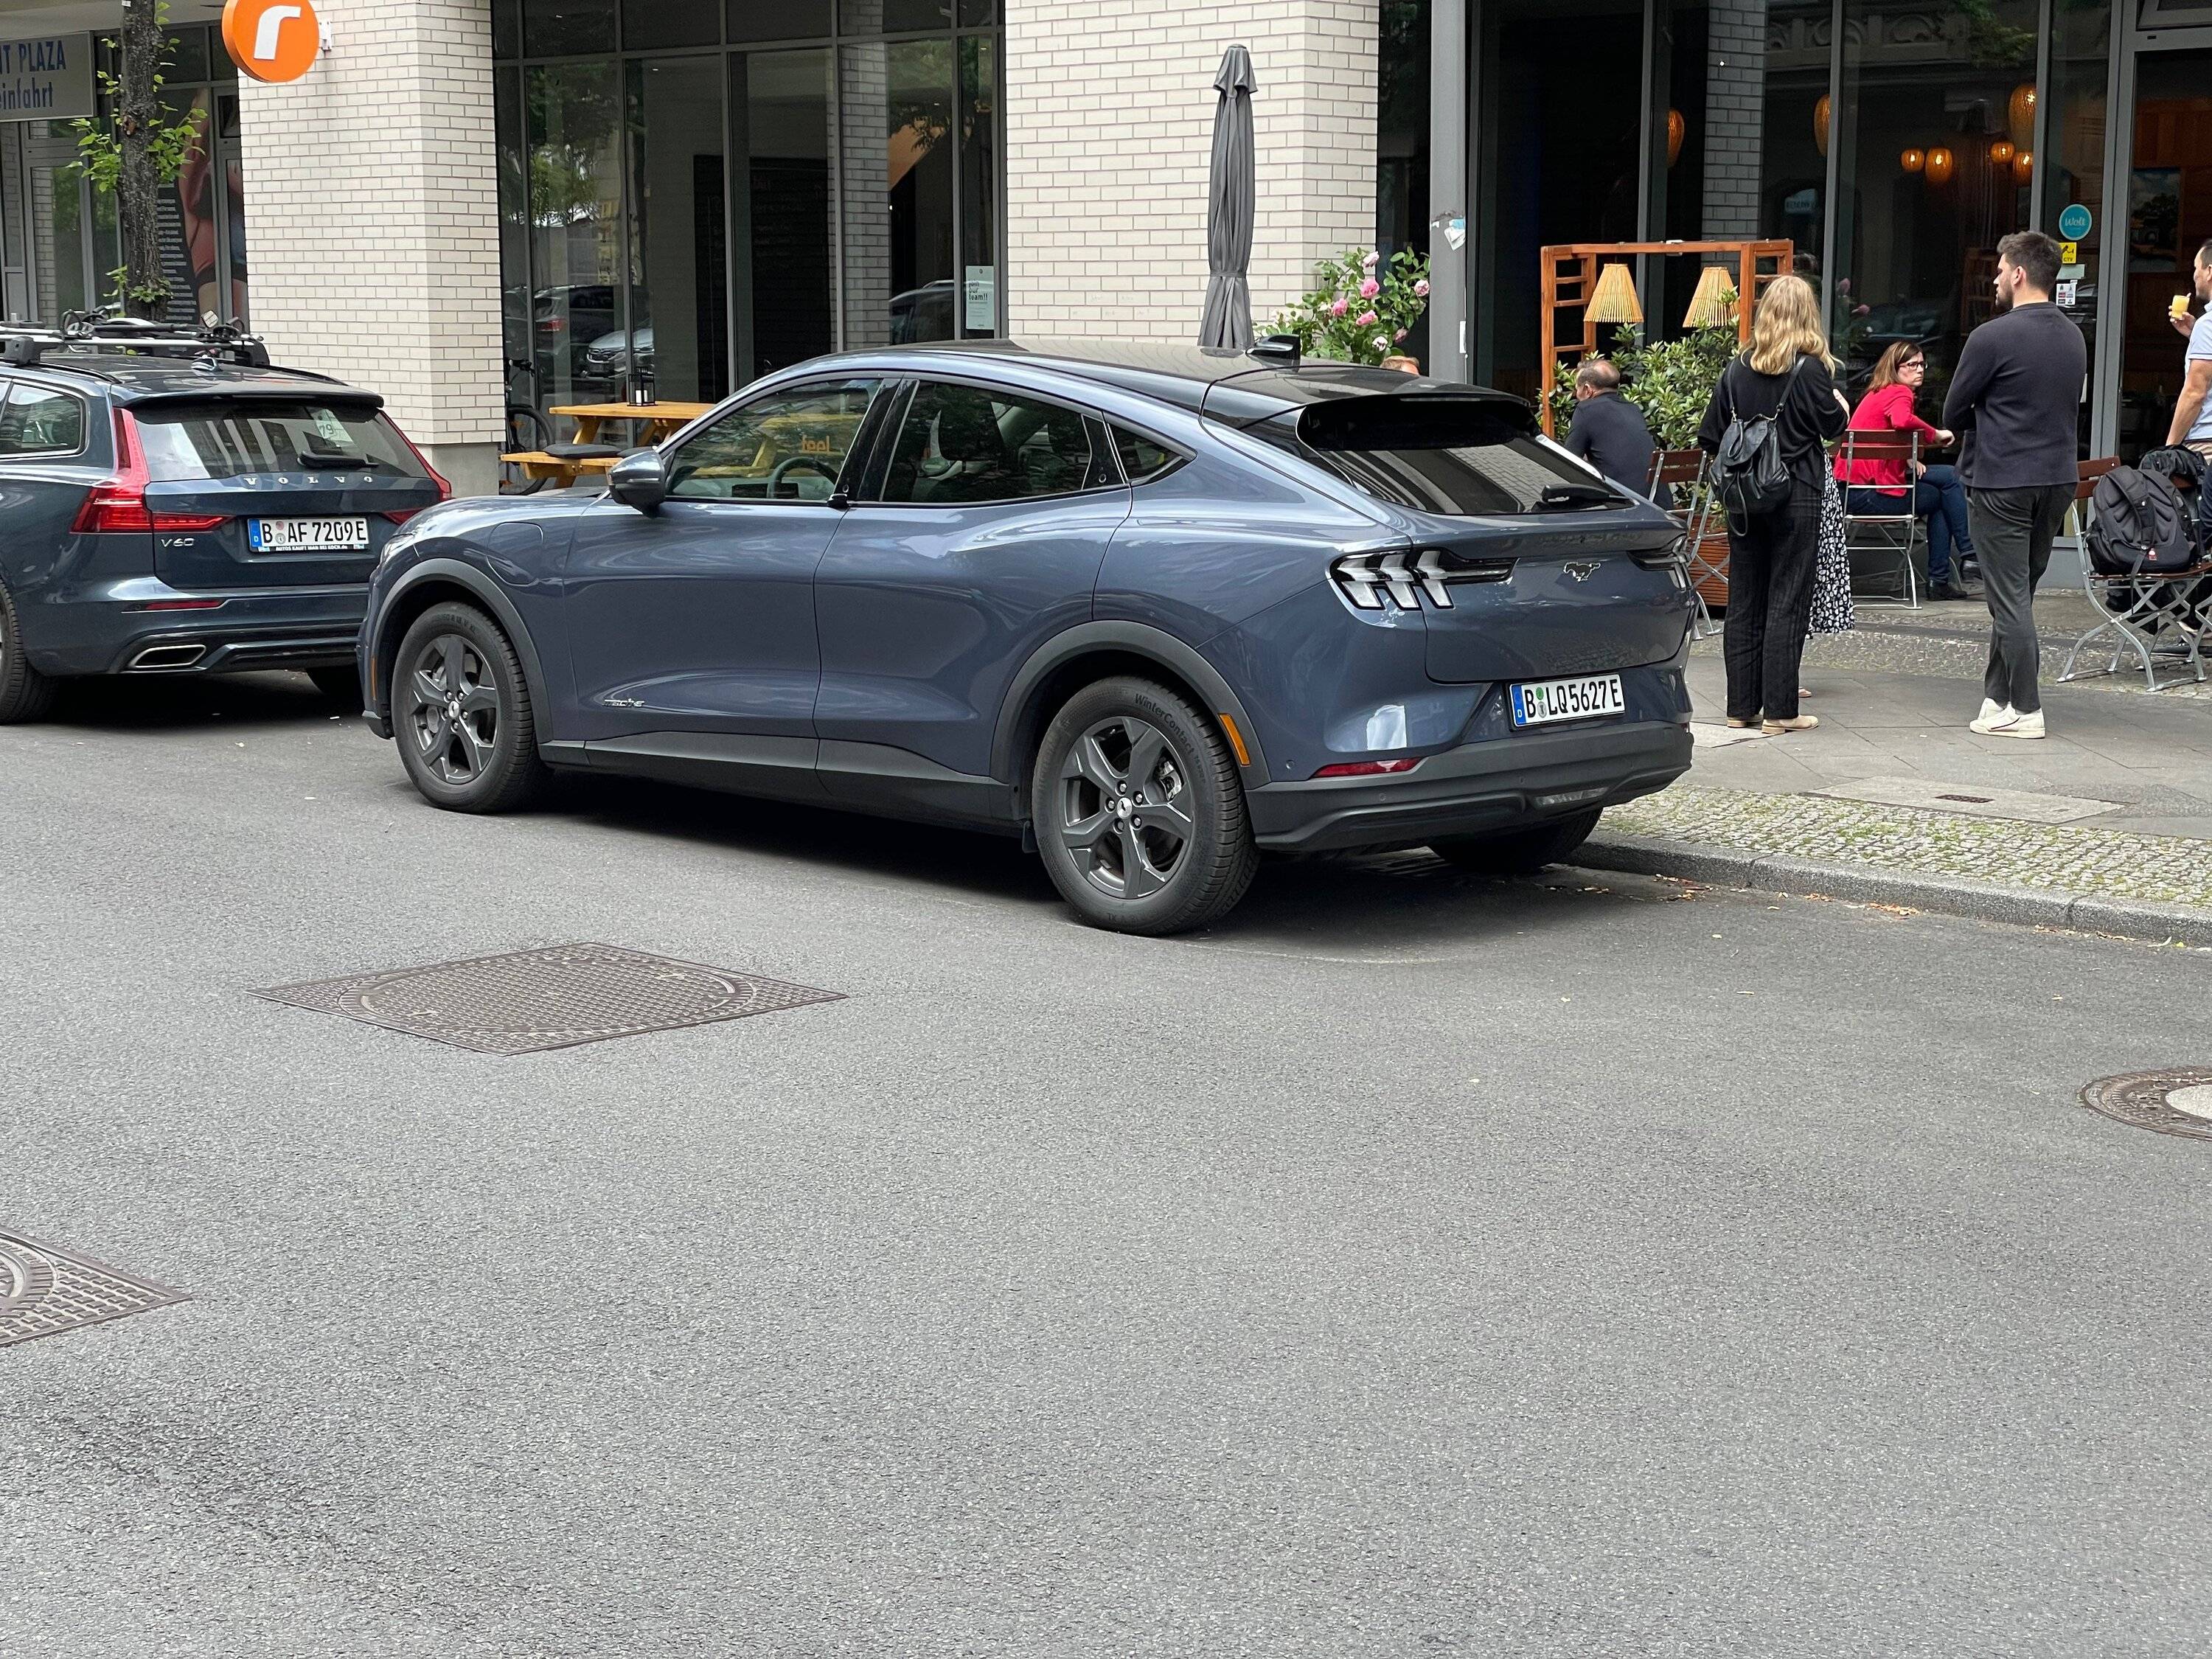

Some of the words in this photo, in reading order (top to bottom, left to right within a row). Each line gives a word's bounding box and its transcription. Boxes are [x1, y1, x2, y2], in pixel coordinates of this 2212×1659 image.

[0, 45, 10, 74] T
[18, 40, 66, 72] PLAZA
[0, 77, 52, 110] infahrt
[243, 476, 373, 485] VOLVO
[161, 538, 195, 547] V60
[262, 523, 273, 543] B
[288, 522, 307, 543] AF
[1517, 709, 1523, 718] D
[1524, 689, 1536, 718] B
[1134, 693, 1195, 754] WinterContact
